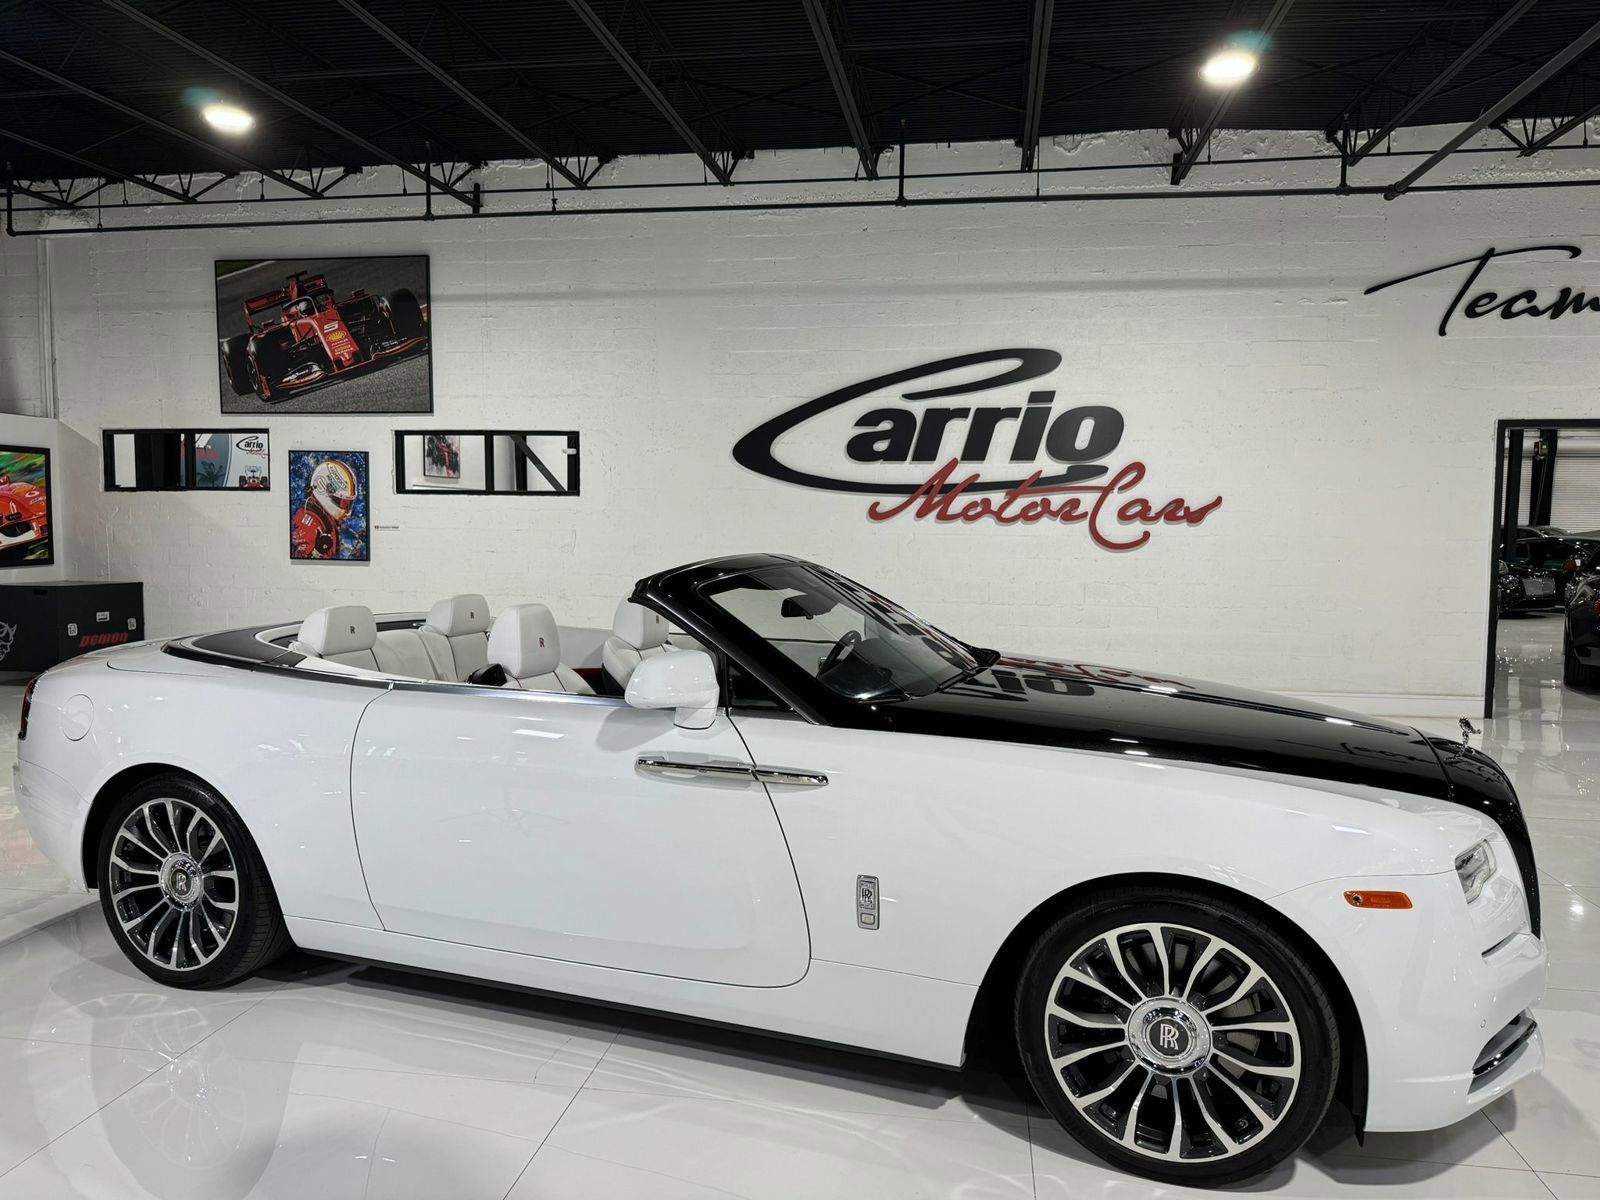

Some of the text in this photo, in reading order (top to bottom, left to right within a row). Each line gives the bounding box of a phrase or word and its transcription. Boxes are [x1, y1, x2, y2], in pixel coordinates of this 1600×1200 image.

[1364, 245, 1600, 336] Team
[236, 435, 264, 452] Carrio
[733, 348, 1124, 495] Carrio
[1159, 1024, 1180, 1050] RR
